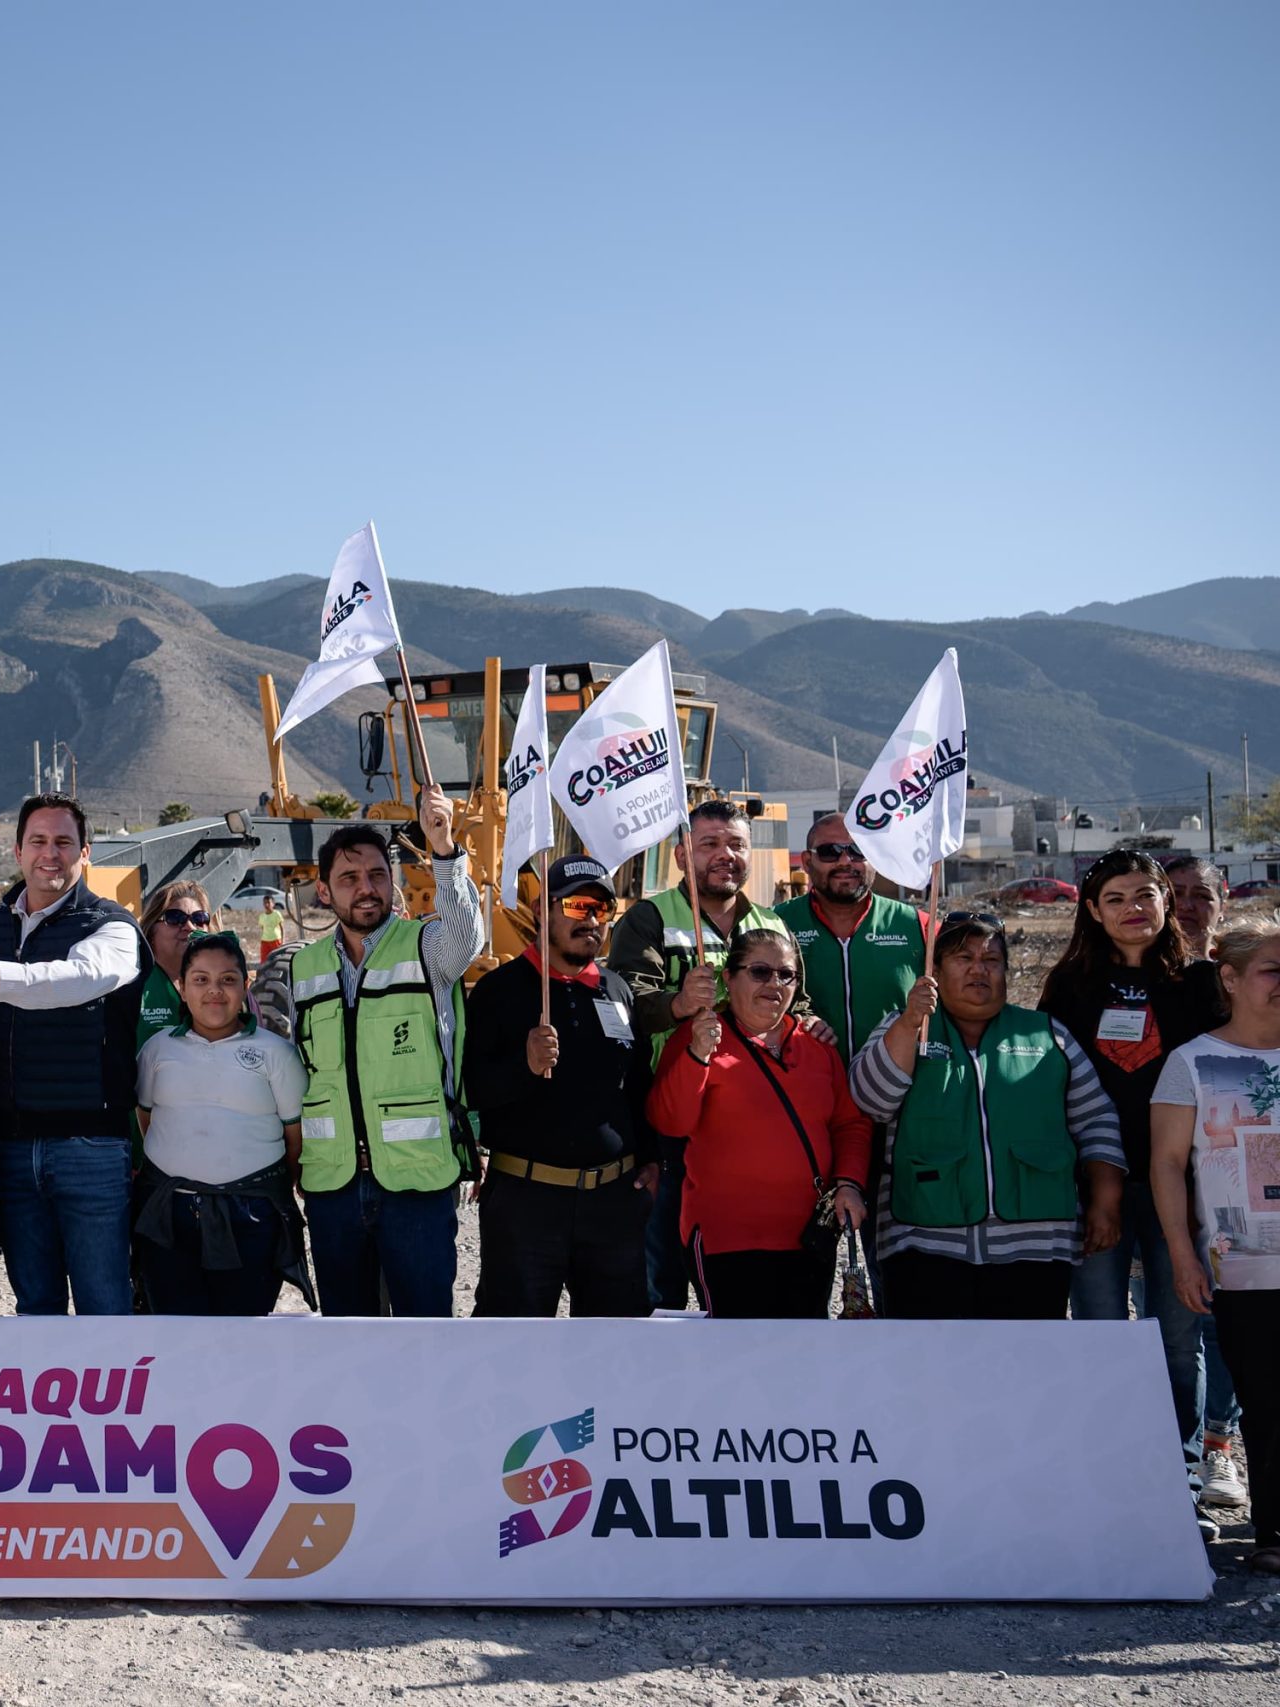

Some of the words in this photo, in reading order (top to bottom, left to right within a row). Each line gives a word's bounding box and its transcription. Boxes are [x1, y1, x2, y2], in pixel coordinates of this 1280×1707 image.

[613, 1428, 701, 1462] POR
[713, 1428, 838, 1463] AMOR
[850, 1429, 878, 1464] A
